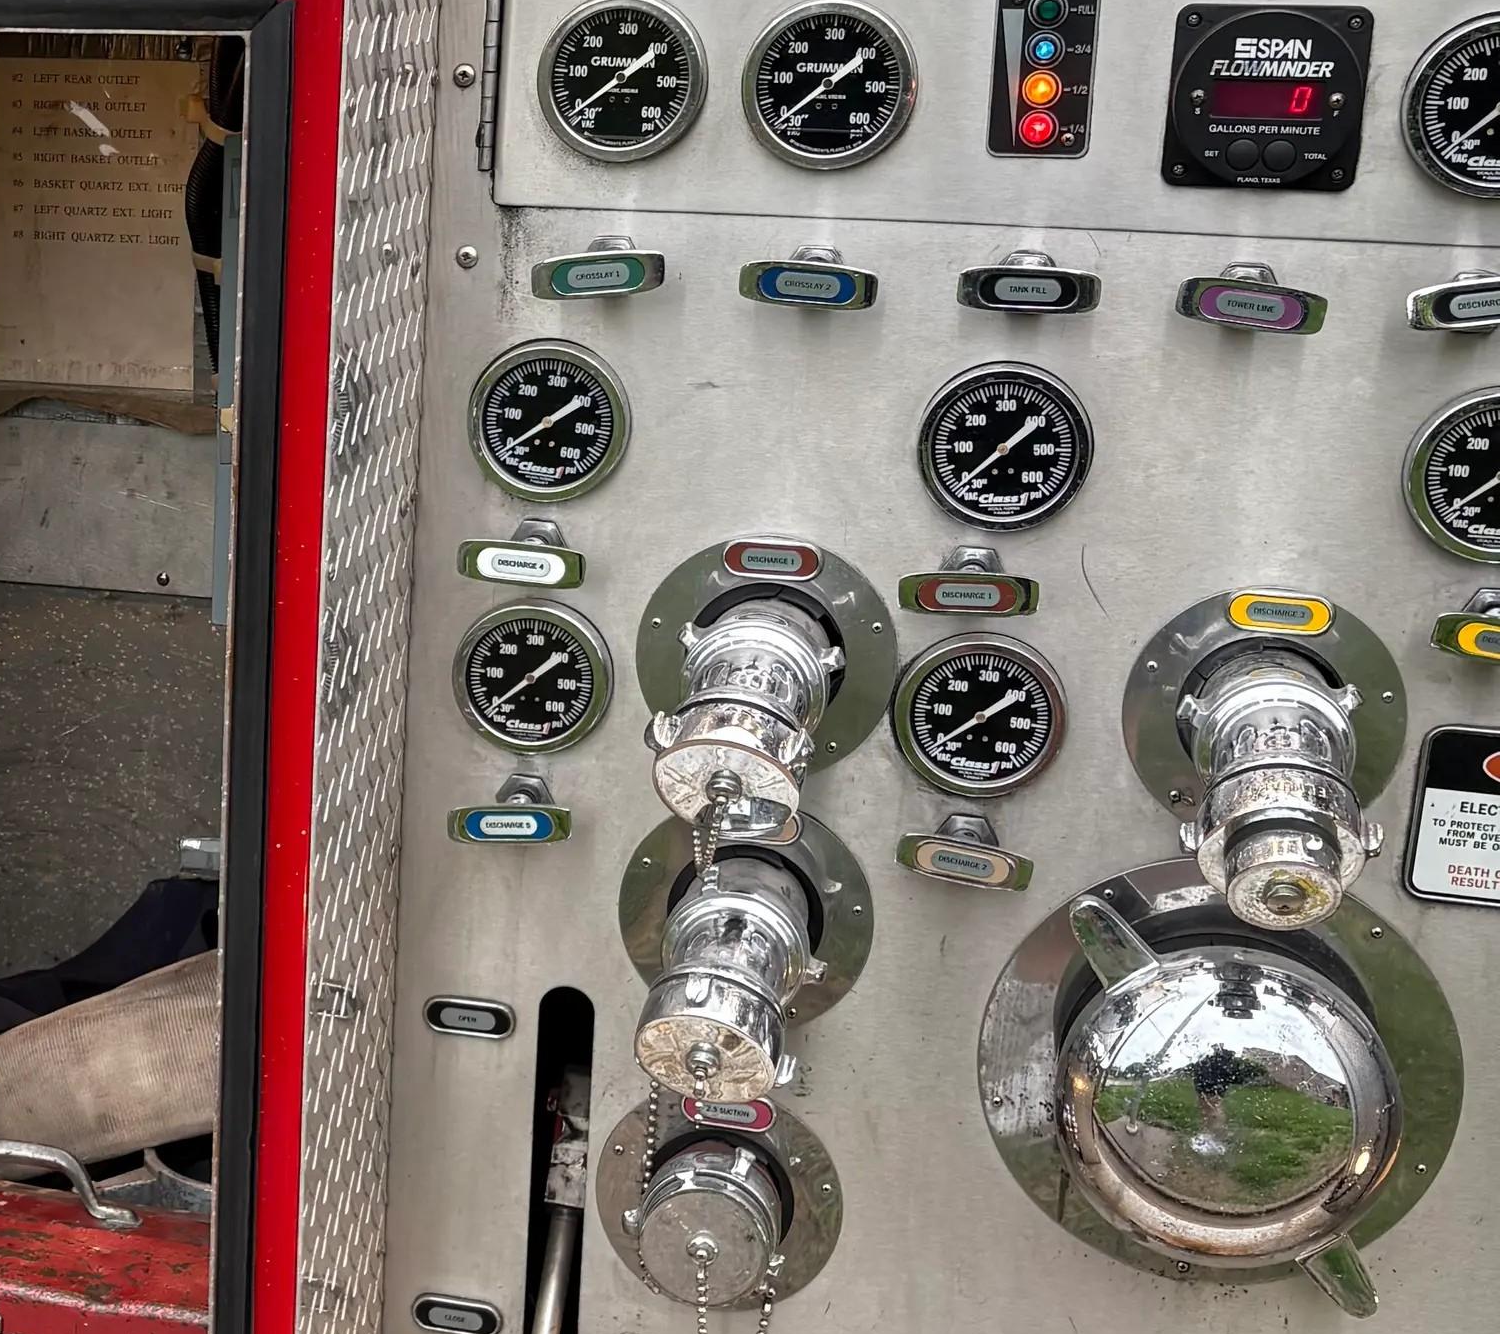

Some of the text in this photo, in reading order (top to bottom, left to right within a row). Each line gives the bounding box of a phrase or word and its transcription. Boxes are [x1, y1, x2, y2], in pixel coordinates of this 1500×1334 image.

[1078, 6, 1095, 14] FULL
[618, 23, 638, 35] 300
[825, 29, 845, 40] 300
[583, 36, 602, 47] 200
[788, 42, 808, 53] 200
[1075, 45, 1091, 53] 3/4
[569, 66, 587, 77] 100
[1210, 60, 1334, 78] FLOWMINDER
[1463, 68, 1487, 80] 200
[34, 74, 140, 85] LEFT REAR OUTLET
[657, 76, 676, 87] 500
[774, 72, 793, 83] 100
[865, 82, 885, 93] 500
[1072, 86, 1088, 95] 1/2
[1291, 87, 1312, 112] 0
[1447, 97, 1469, 109] 100
[105, 102, 147, 112] OUTLET
[641, 107, 661, 118] 600
[581, 120, 594, 128] VAC
[850, 113, 869, 124] 600
[642, 121, 654, 132] psi
[1209, 125, 1320, 135] GALLONS PER MINUTE
[110, 129, 152, 139] OUTLET
[71, 154, 112, 165] BASKET
[117, 156, 160, 166] OUTLET
[34, 179, 75, 189] BASKET
[80, 181, 123, 191] QUARTZ
[34, 205, 60, 214] LEFT
[64, 207, 108, 217] QUARTZ
[141, 209, 172, 219] LIGHT
[34, 231, 66, 241] RIGHT
[71, 233, 115, 243] QUARTZ
[149, 236, 180, 246] LIGHT
[576, 272, 613, 280] CROSSLAY
[785, 280, 824, 290] CROSSLAY
[1032, 286, 1047, 294] FILL
[1227, 300, 1254, 309] TOWER
[548, 375, 567, 387] 300
[518, 384, 537, 397] 200
[996, 400, 1016, 411] 300
[504, 408, 522, 420] 100
[965, 415, 986, 426] 200
[575, 423, 594, 435] 500
[954, 441, 973, 452] 100
[1034, 444, 1054, 455] 500
[1467, 438, 1489, 450] 200
[560, 447, 580, 459] 600
[1022, 471, 1043, 482] 600
[1448, 465, 1469, 477] 100
[498, 559, 537, 569] DISCHARGE
[748, 556, 788, 564] DISCHARGE
[1254, 608, 1298, 617] DISCHARGE
[526, 634, 544, 645] 300
[500, 644, 517, 655] 200
[486, 667, 503, 678] 100
[979, 670, 999, 682] 300
[558, 679, 576, 690] 500
[948, 680, 968, 692] 200
[546, 701, 564, 712] 600
[934, 704, 952, 715] 100
[1010, 717, 1030, 729] 500
[995, 741, 1016, 754] 600
[1460, 801, 1500, 816] ELEC
[1450, 821, 1496, 832] PROTECT
[1447, 829, 1475, 839] FROM
[1439, 837, 1486, 849] MUST BE
[939, 855, 979, 868] DISCHARGE
[1448, 865, 1489, 878] DEATH
[1451, 876, 1496, 890] RESULT
[720, 1108, 749, 1117] SUCTION
